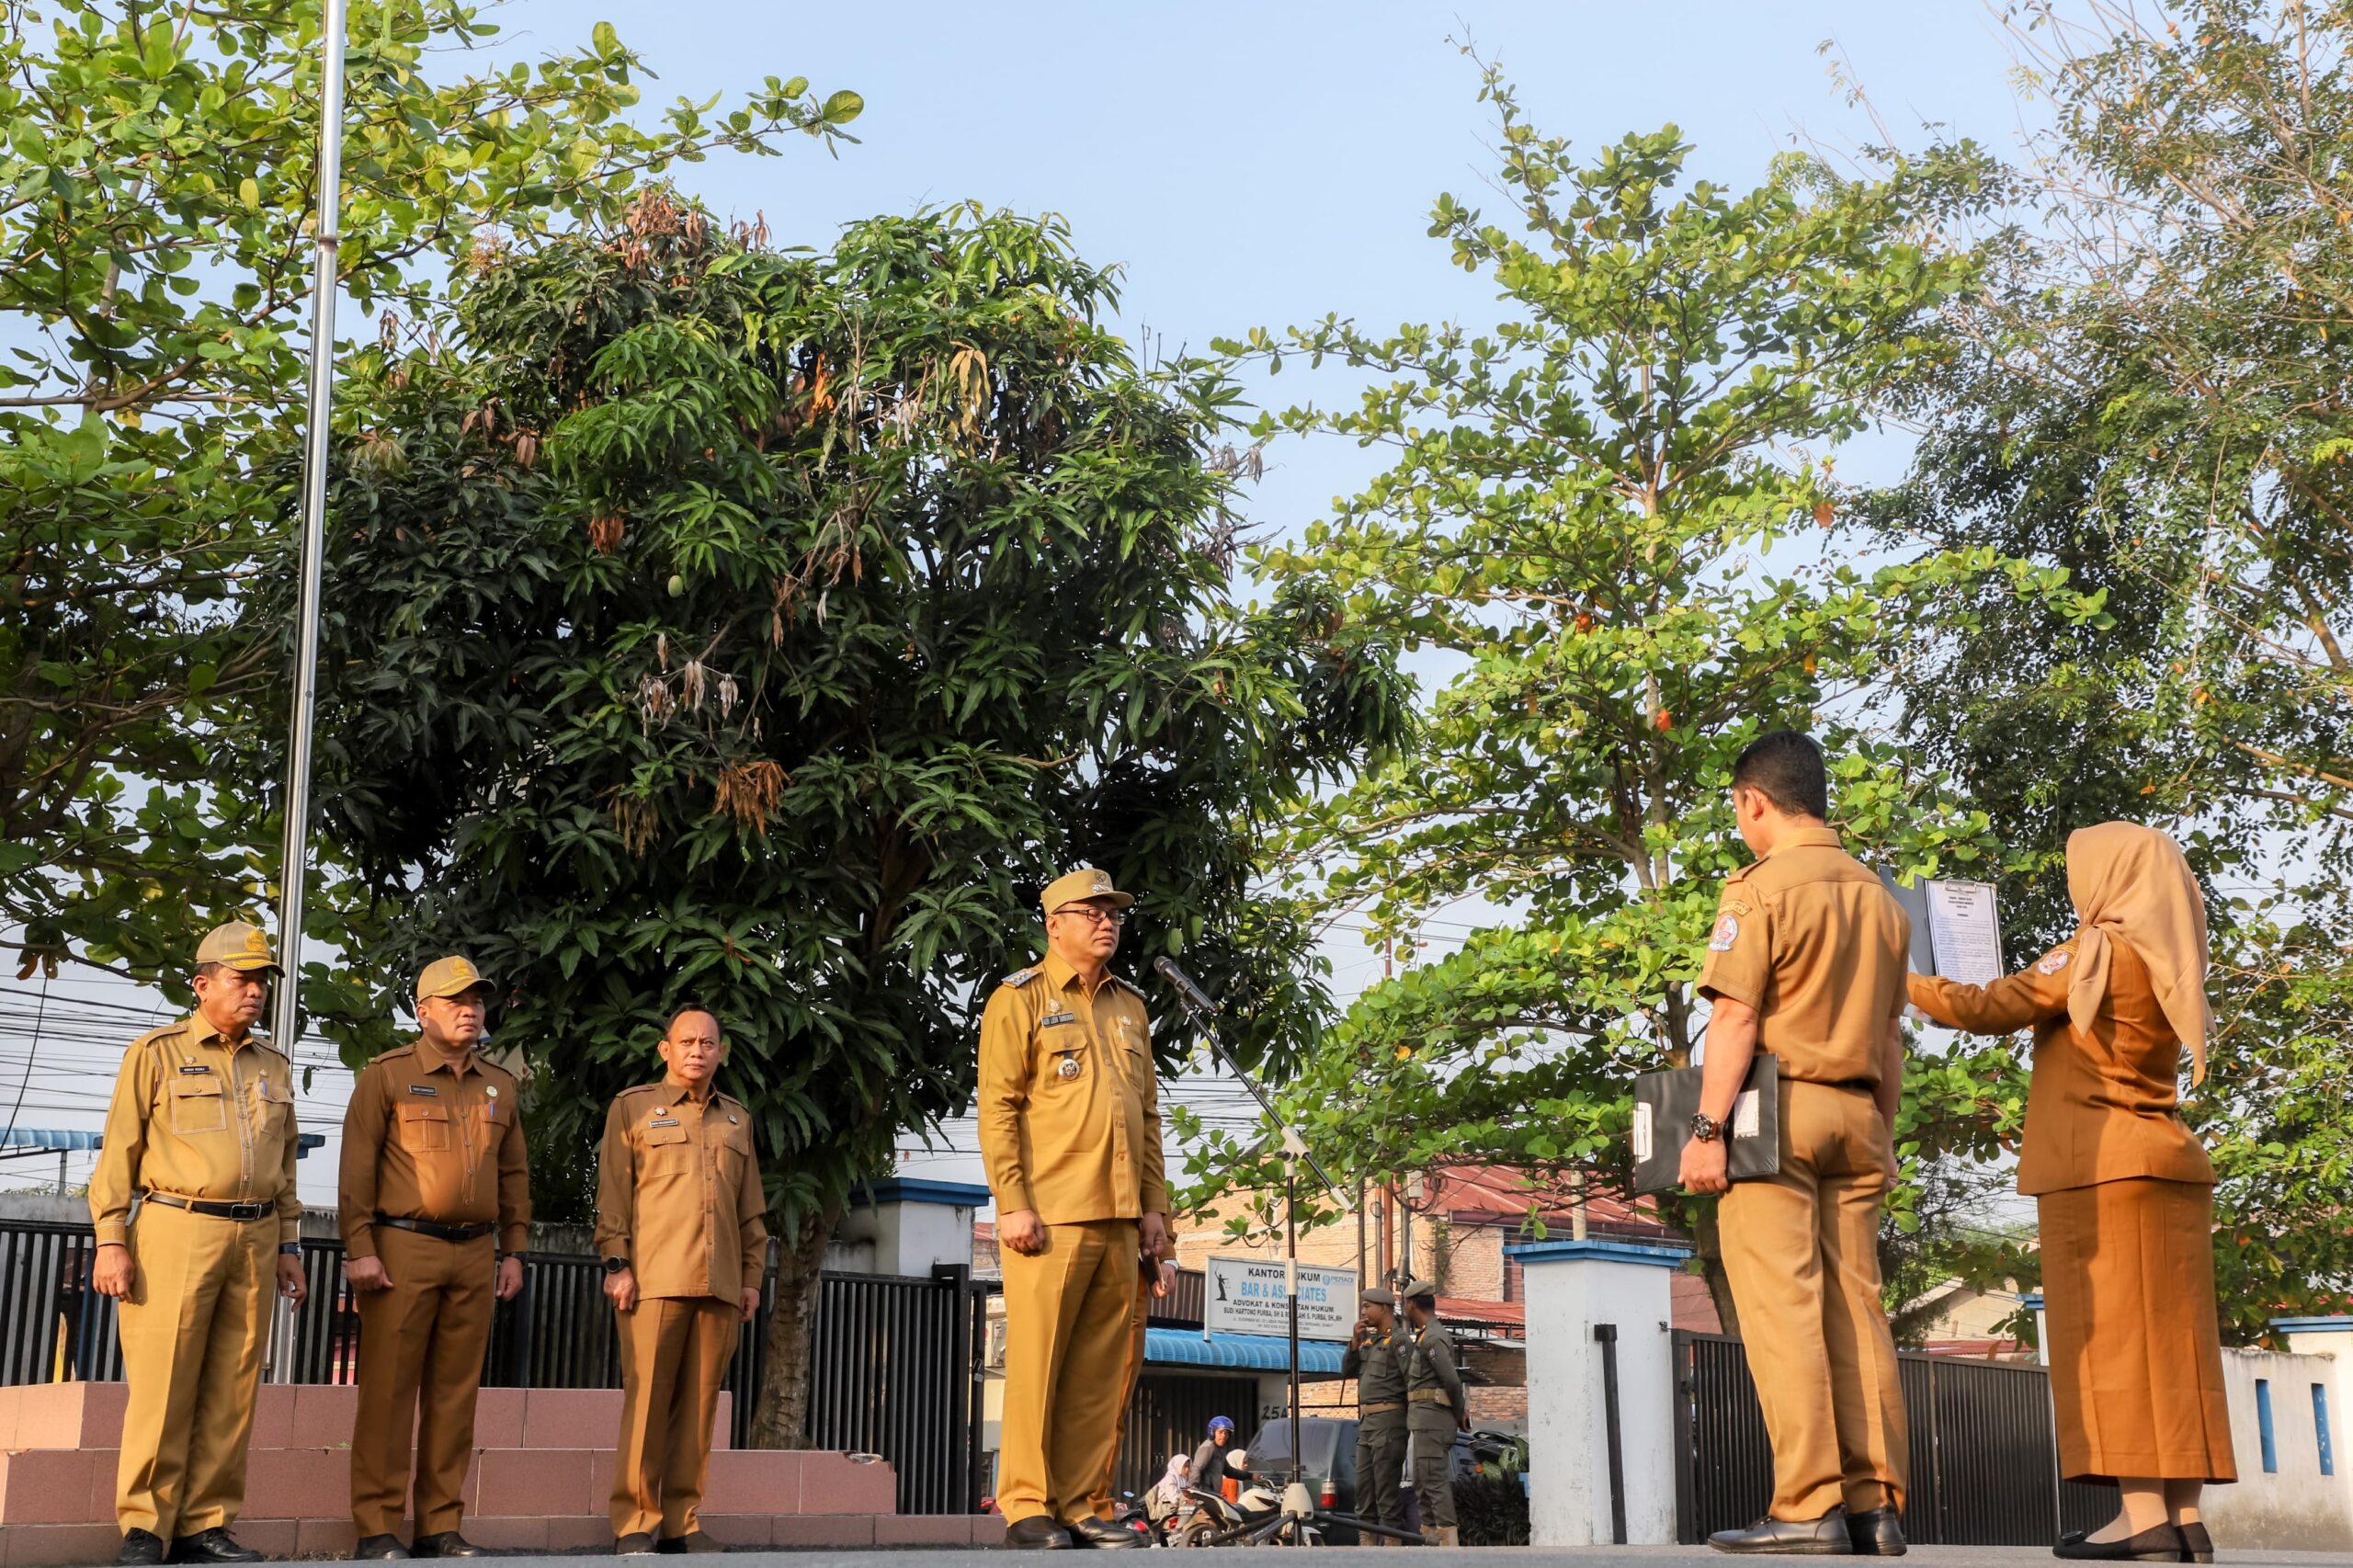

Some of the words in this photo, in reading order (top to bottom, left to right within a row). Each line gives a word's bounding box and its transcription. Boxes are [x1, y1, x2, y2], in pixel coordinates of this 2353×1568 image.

[1248, 1267, 1285, 1278] KANTOR
[1241, 1281, 1259, 1297] BAR
[1262, 1283, 1268, 1297] &
[1233, 1299, 1263, 1308] ADVOKAT
[1261, 1405, 1288, 1420] 25A
